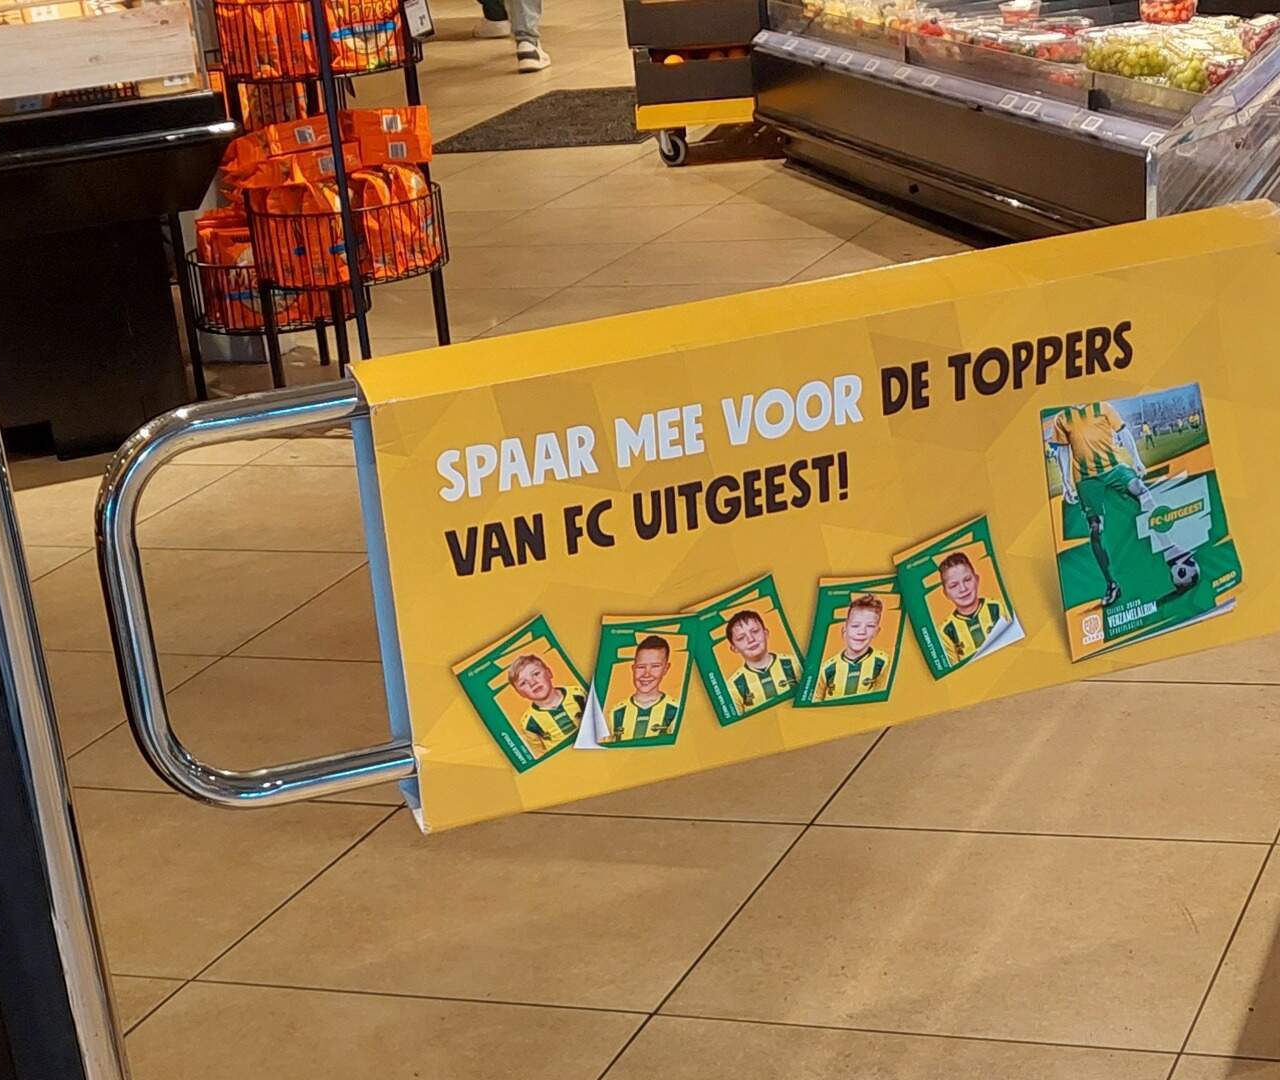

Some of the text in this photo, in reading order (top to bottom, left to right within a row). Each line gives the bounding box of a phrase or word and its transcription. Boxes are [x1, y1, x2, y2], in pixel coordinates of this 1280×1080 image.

[436, 321, 1135, 502] SPAAR MEE VOOR DE TOPPERS
[444, 451, 850, 578] VAN FC UITGEEST!
[1107, 600, 1157, 628] VERZAMELALBUM
